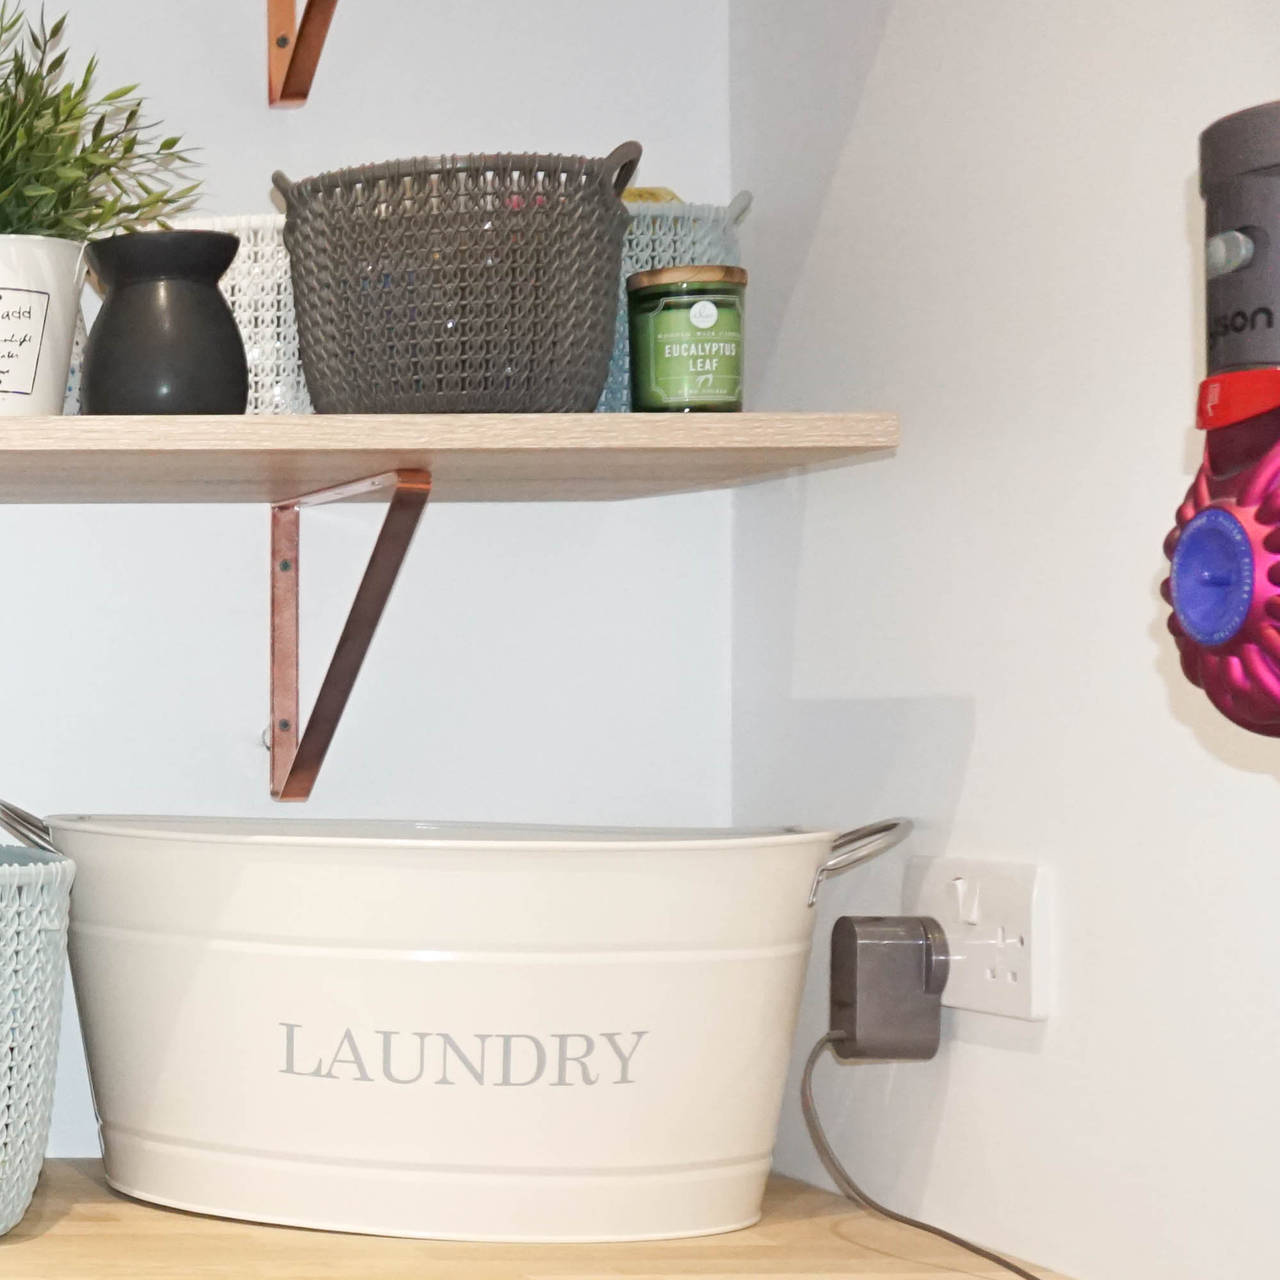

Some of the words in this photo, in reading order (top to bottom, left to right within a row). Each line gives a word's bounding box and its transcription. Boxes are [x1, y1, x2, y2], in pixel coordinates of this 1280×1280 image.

[1, 305, 32, 320] add
[665, 342, 736, 358] EUCALYPTUS
[690, 358, 719, 372] LEAF
[277, 1022, 650, 1087] LAUNDRY
